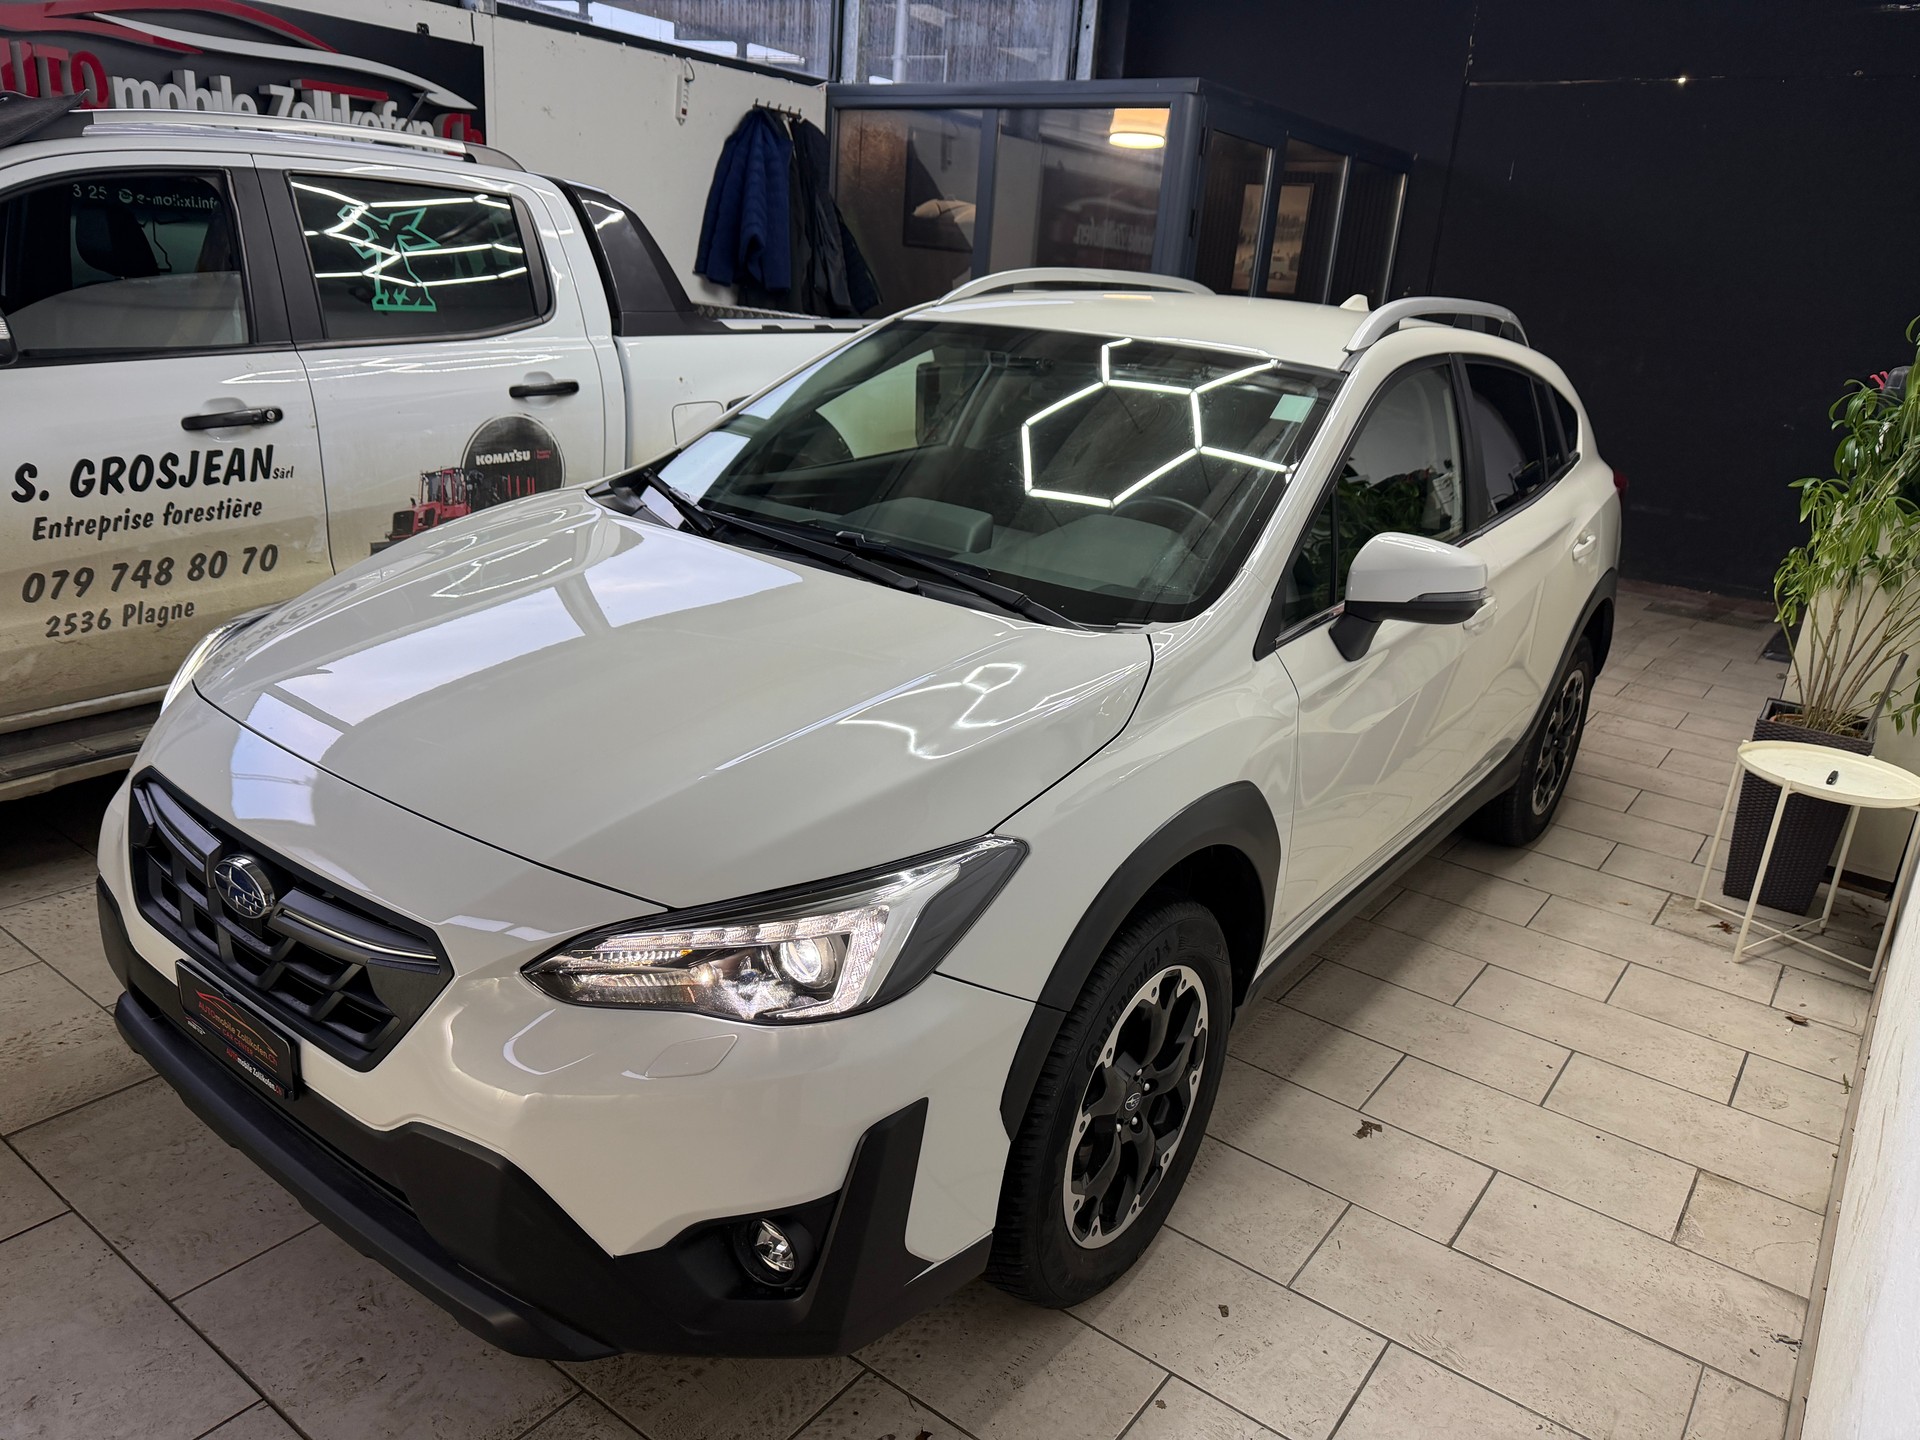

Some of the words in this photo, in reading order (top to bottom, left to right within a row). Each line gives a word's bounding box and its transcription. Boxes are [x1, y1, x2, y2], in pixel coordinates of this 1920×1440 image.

[11, 462, 50, 503] S.
[69, 444, 274, 498] GROSJEAN
[272, 465, 294, 479] Sàrl
[475, 449, 531, 466] KOMATSU
[32, 508, 154, 541] Entreprise
[162, 498, 263, 526] forestière
[21, 566, 94, 603] 079
[111, 556, 175, 592] 748
[187, 550, 228, 581] 80
[242, 544, 278, 575] 70
[45, 608, 112, 637] 2536
[122, 601, 195, 628] Plagne
